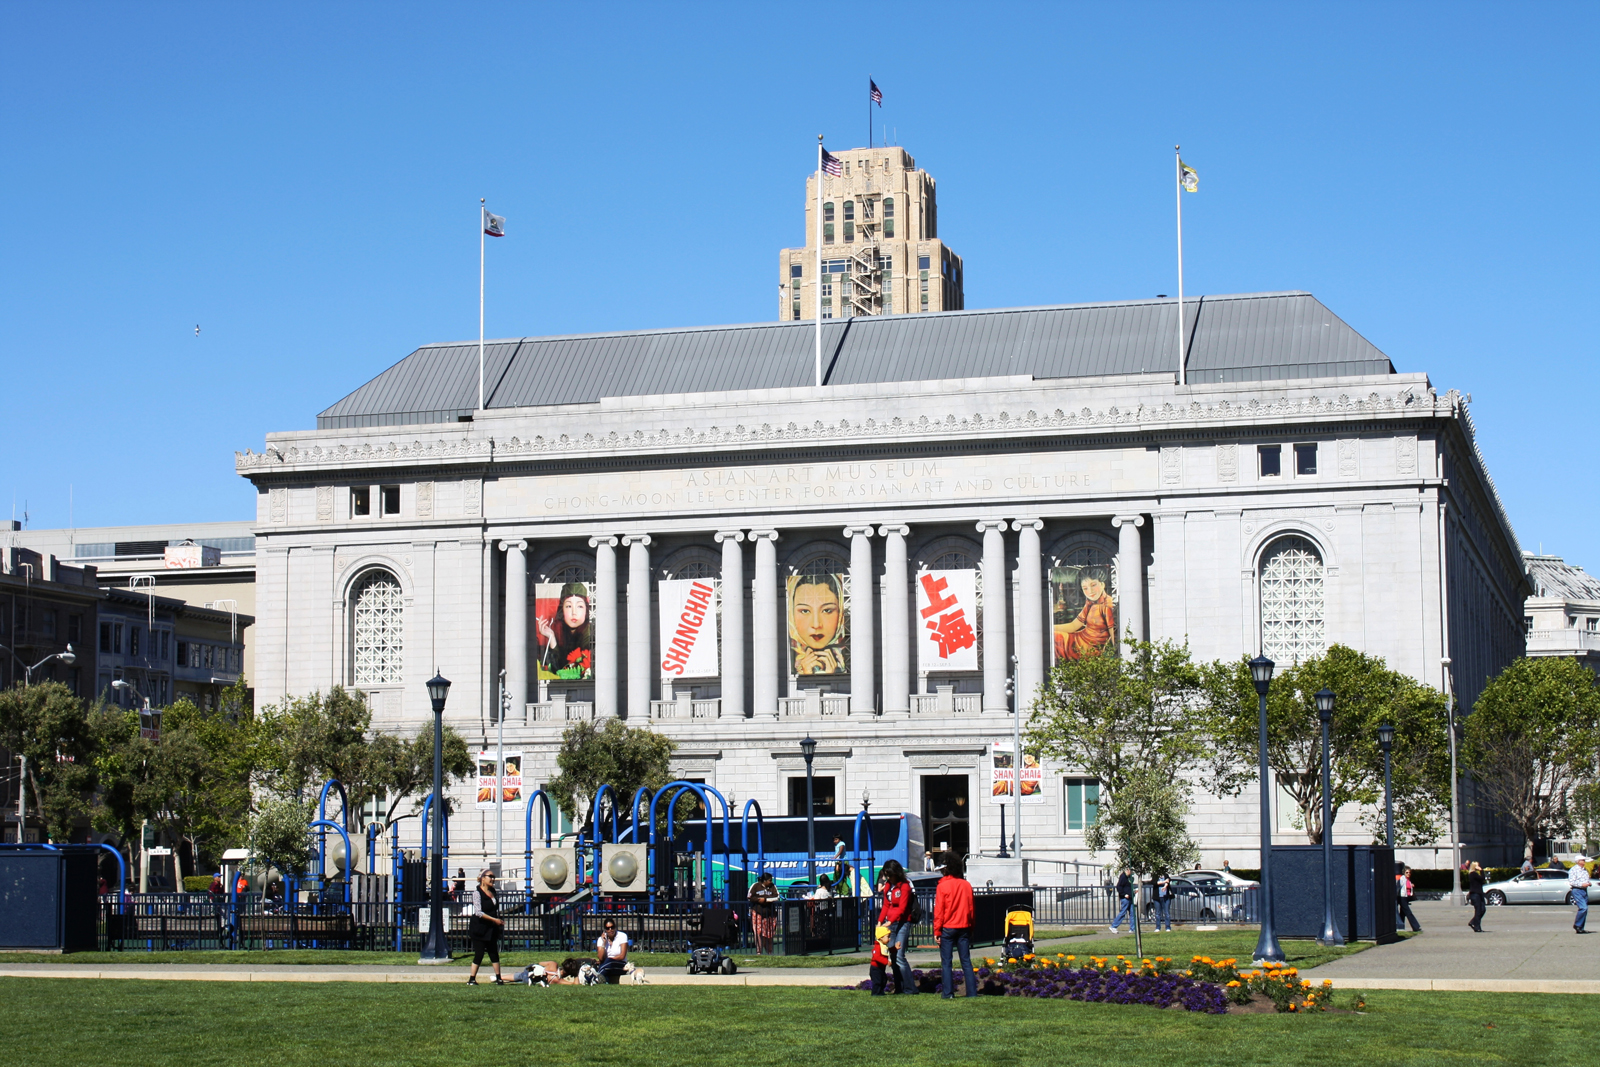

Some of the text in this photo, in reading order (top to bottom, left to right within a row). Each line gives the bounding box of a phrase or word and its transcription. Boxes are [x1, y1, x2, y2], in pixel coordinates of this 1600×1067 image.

[544, 474, 1090, 509] CHONG-MOON LEE CENTER FOR ASIAN ART AND CULTURE
[685, 461, 939, 487] ASIAN ART MUSEUM
[662, 581, 713, 675] SHANGHAI
[920, 573, 977, 659] 上海
[5, 833, 37, 843] HOEL
